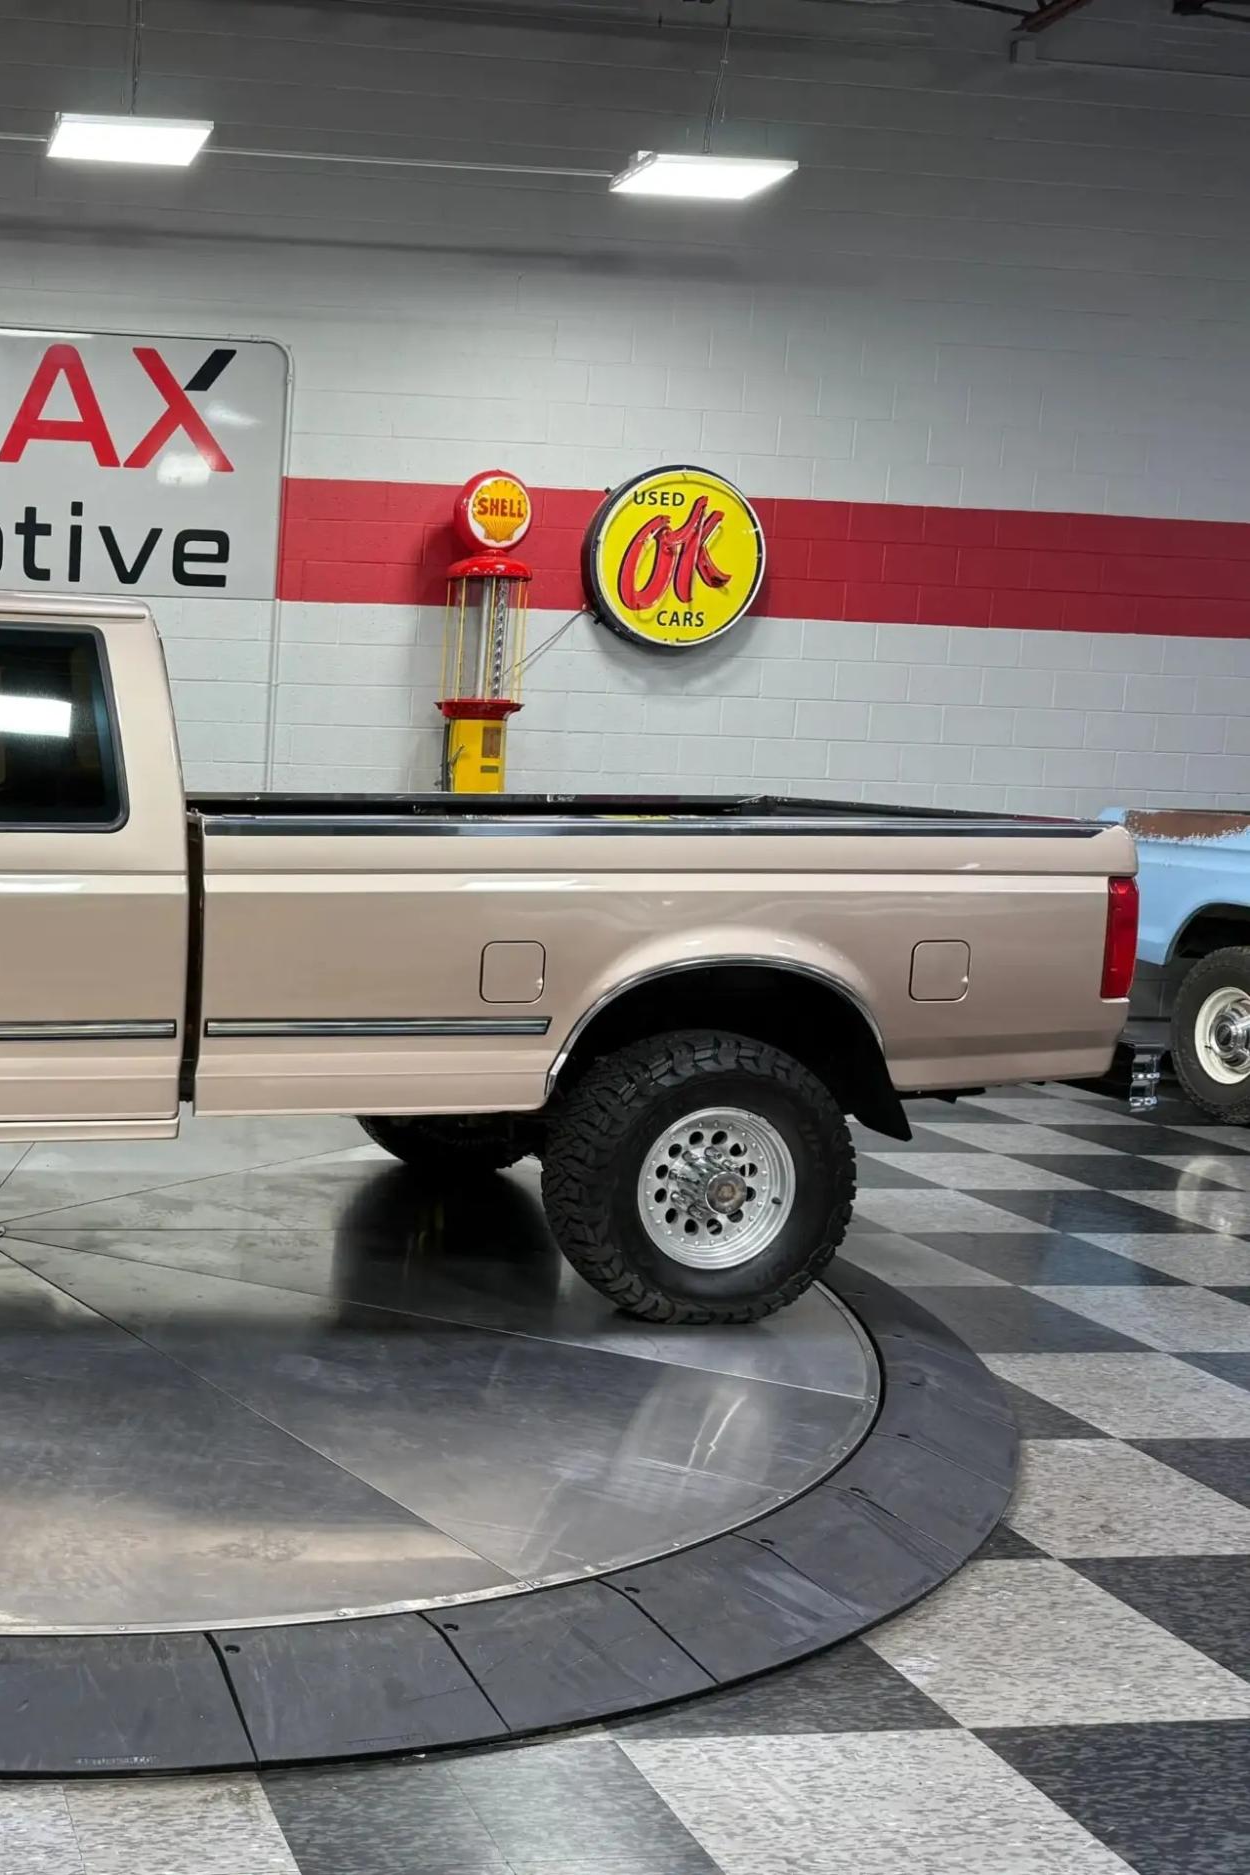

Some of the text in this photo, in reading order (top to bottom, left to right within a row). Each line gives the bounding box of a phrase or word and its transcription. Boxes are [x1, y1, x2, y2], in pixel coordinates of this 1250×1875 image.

[477, 497, 524, 518] SHELL
[633, 490, 686, 507] USED
[617, 495, 732, 611] OK
[656, 610, 705, 627] CARS
